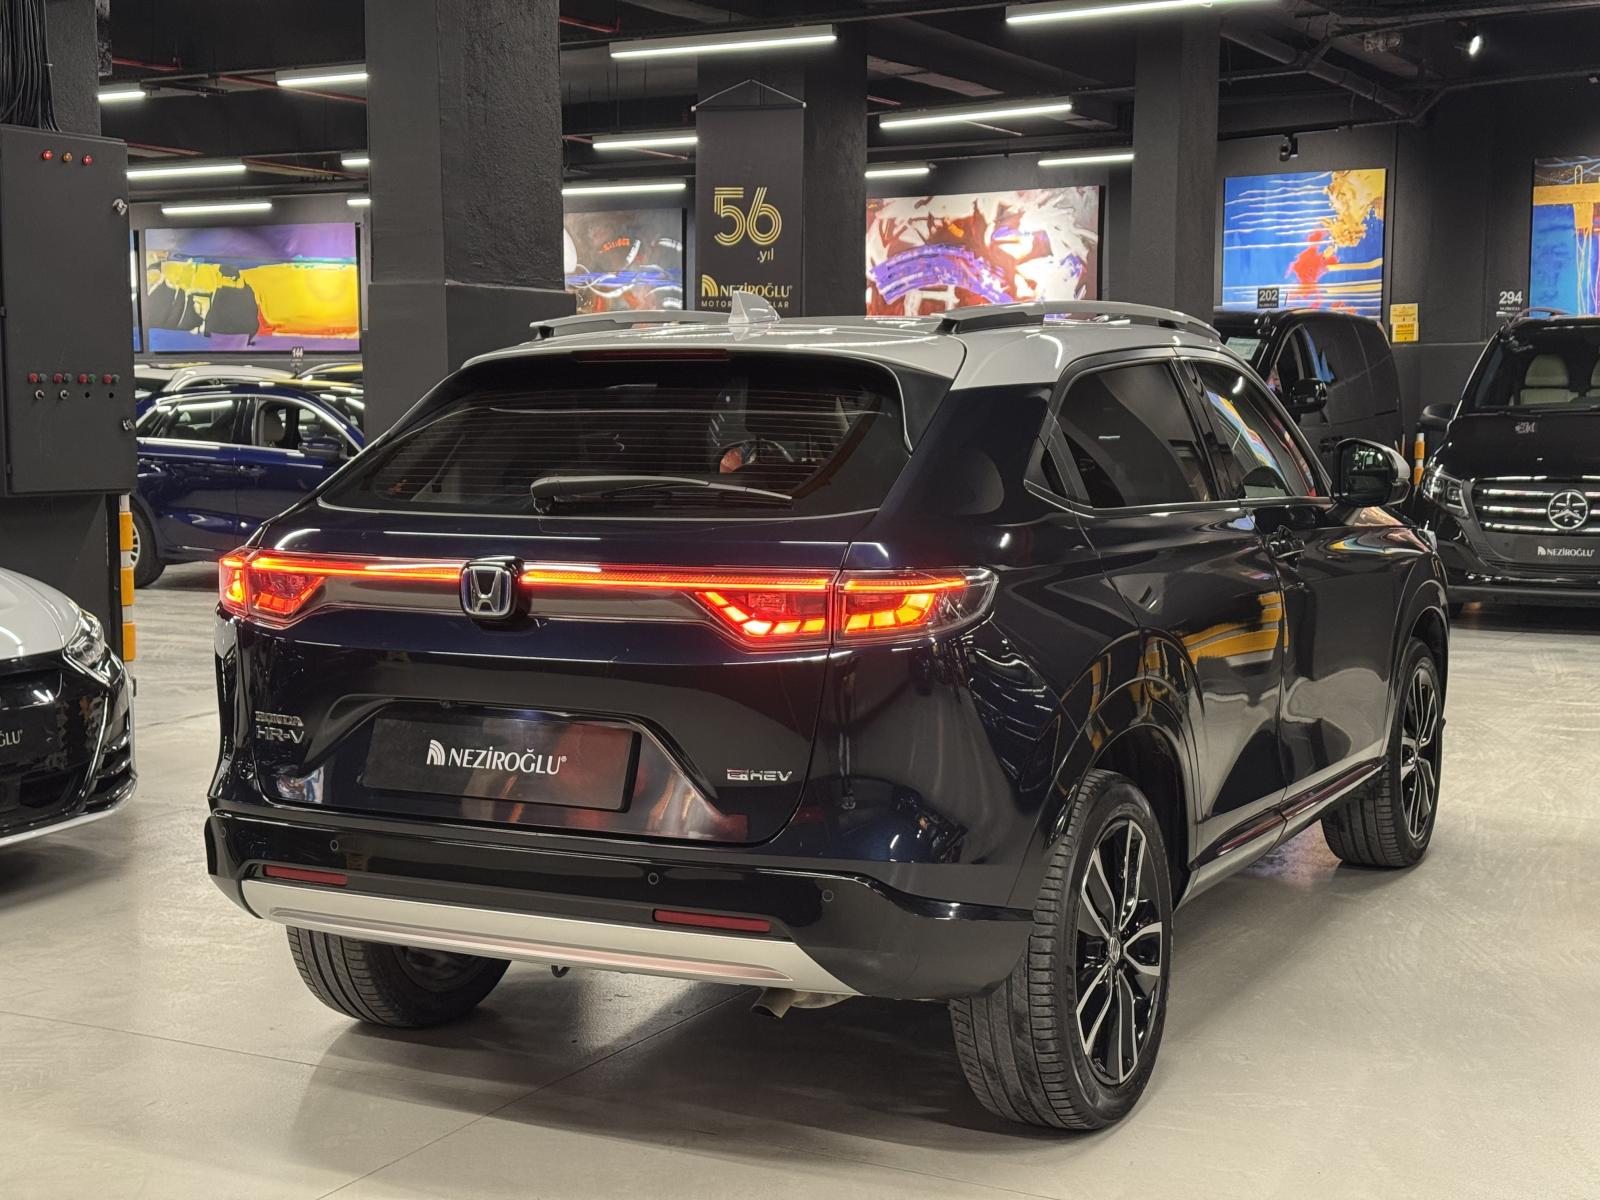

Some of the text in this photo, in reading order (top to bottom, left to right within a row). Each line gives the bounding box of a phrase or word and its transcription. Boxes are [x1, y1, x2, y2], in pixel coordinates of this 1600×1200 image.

[714, 187, 782, 246] 56
[1259, 290, 1278, 301] 202
[1499, 290, 1523, 304] 294
[256, 725, 304, 744] HR-V
[448, 746, 561, 775] NEZİROĞLU
